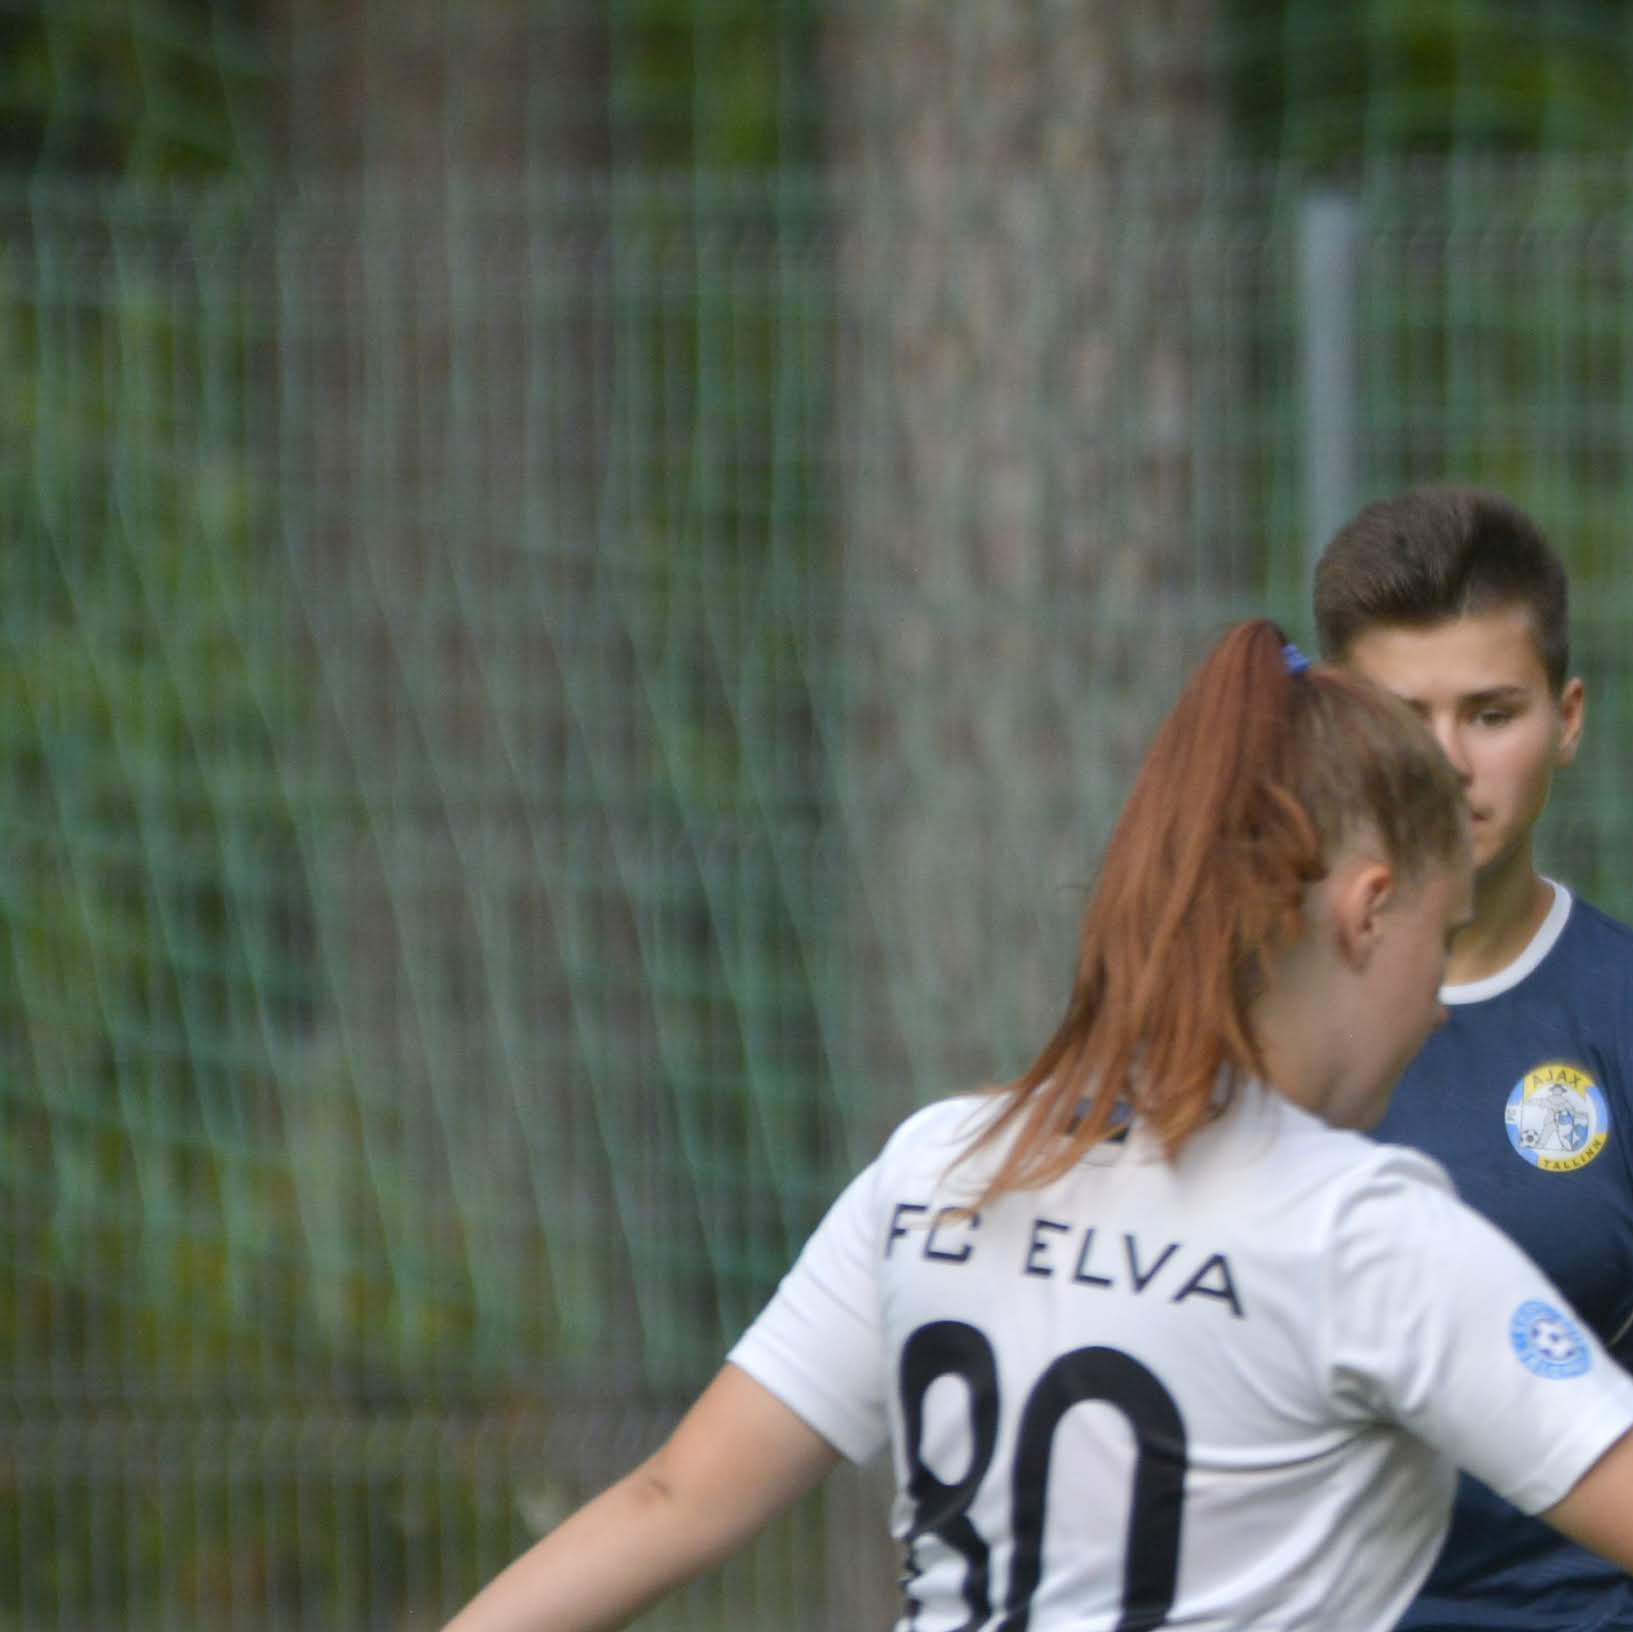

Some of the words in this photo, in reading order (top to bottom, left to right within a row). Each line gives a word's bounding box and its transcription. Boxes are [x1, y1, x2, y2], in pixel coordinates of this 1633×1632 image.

[1532, 1069, 1582, 1088] AJAX
[1543, 1139, 1602, 1170] TALLINN
[885, 1202, 981, 1264] FC
[1023, 1216, 1245, 1319] ELVA
